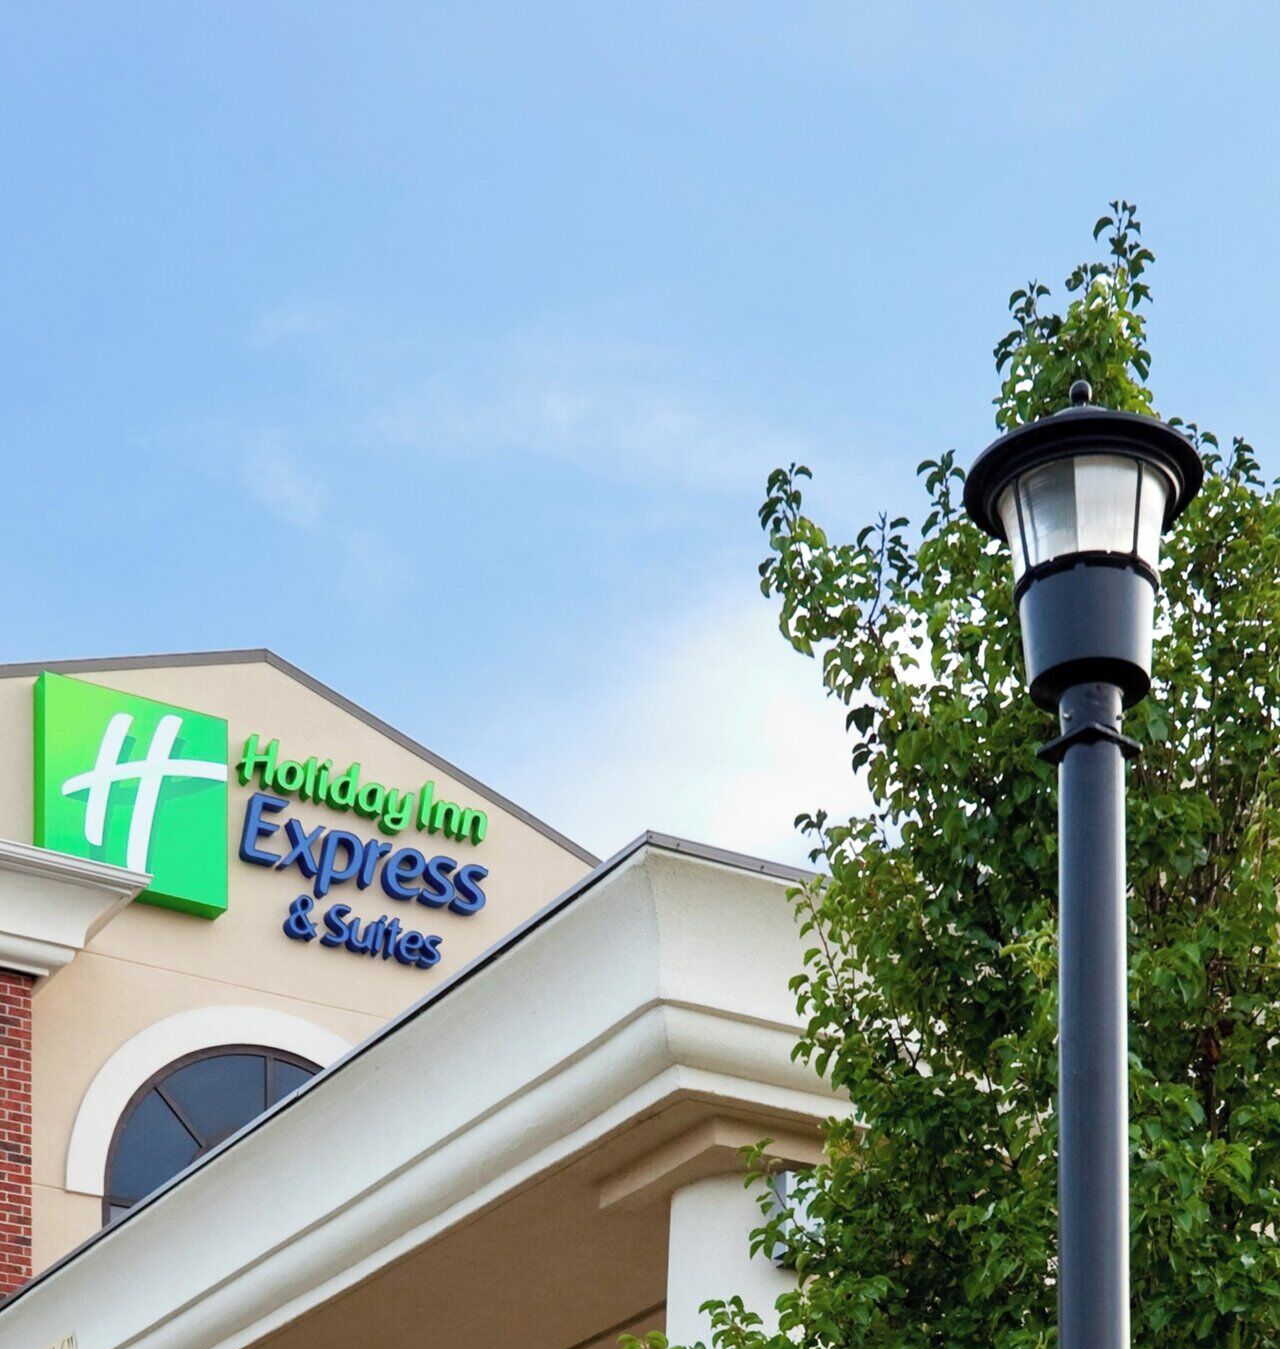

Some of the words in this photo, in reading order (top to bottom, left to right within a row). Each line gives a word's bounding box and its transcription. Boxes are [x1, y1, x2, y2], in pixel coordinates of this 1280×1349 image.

[236, 733, 415, 835] Holiday
[416, 780, 487, 846] Inn
[239, 792, 488, 916] Express
[283, 894, 318, 942] &
[320, 903, 442, 969] Suites
